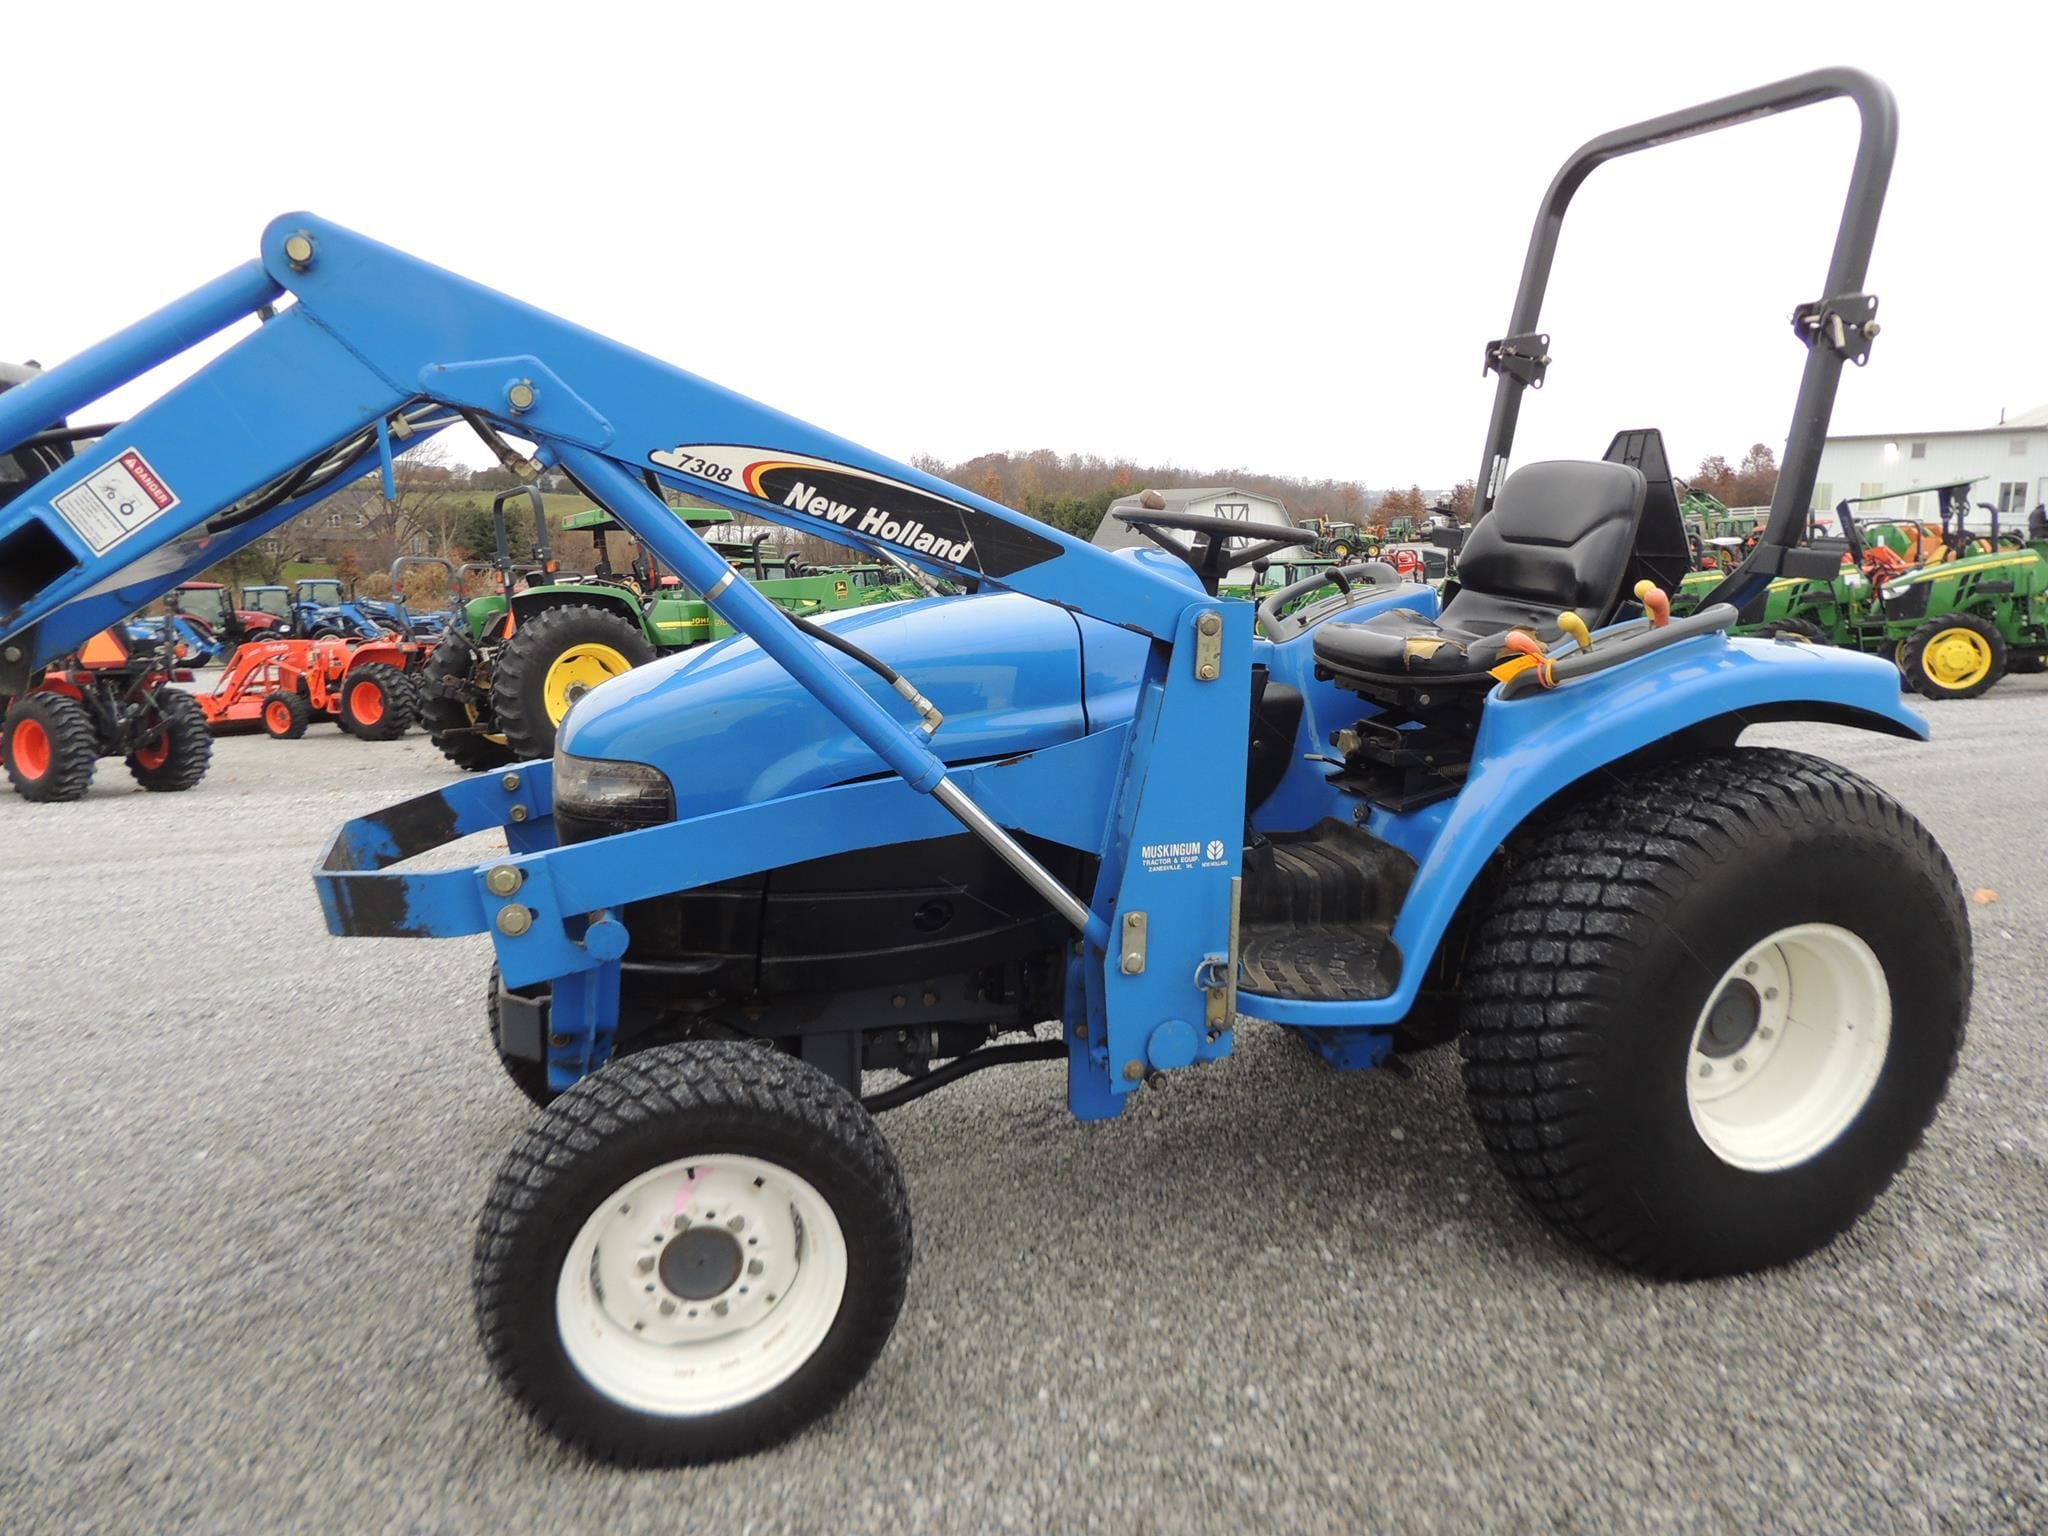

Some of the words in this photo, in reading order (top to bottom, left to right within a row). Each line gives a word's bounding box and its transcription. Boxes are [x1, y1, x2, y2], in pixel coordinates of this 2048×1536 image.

[678, 454, 733, 481] 7308
[135, 466, 168, 503] DANGER
[783, 482, 856, 524] New
[857, 507, 973, 563] Holland
[1142, 842, 1201, 858] MUSKINGUM
[1142, 857, 1171, 866] TRACTOR
